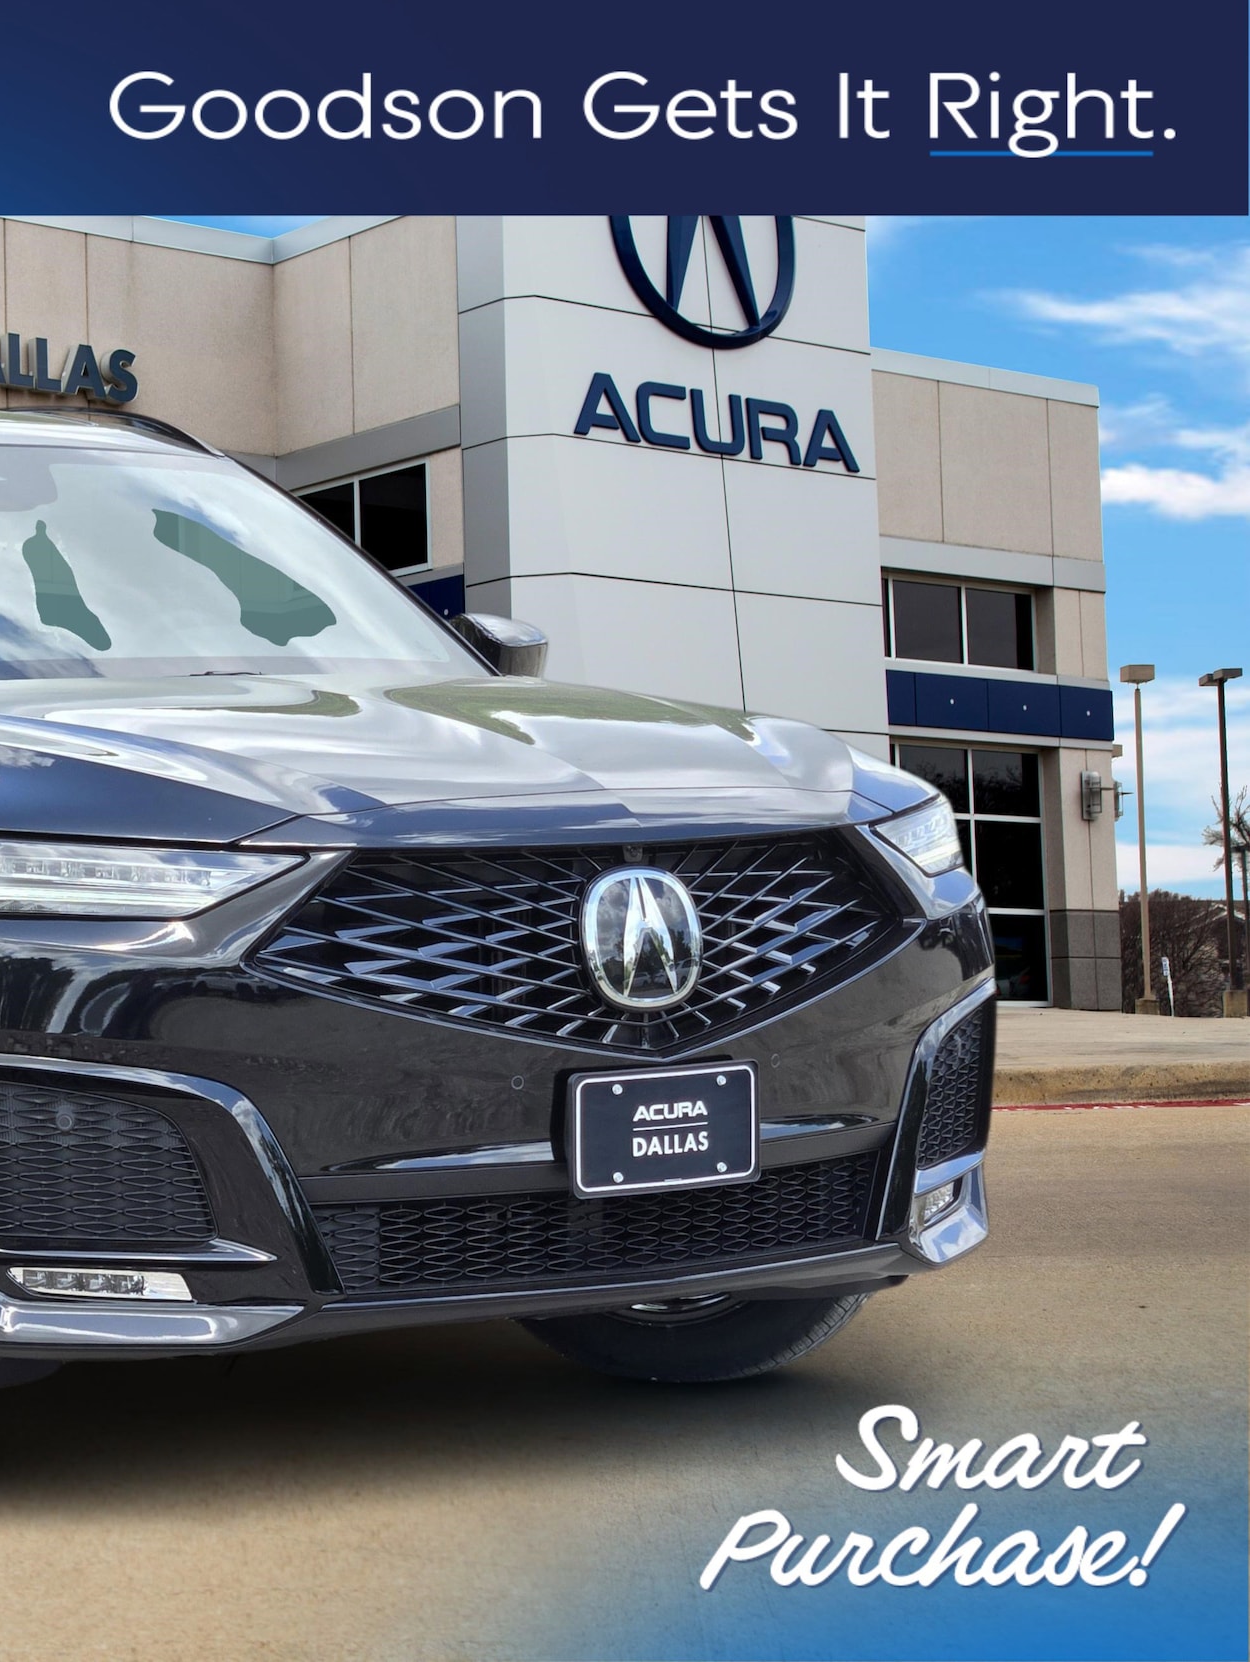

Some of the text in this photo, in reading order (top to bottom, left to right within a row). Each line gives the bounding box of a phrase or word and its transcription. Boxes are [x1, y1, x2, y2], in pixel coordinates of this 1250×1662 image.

[574, 372, 860, 474] ACURA
[632, 1099, 709, 1122] ACURA
[632, 1130, 709, 1158] DALLAS
